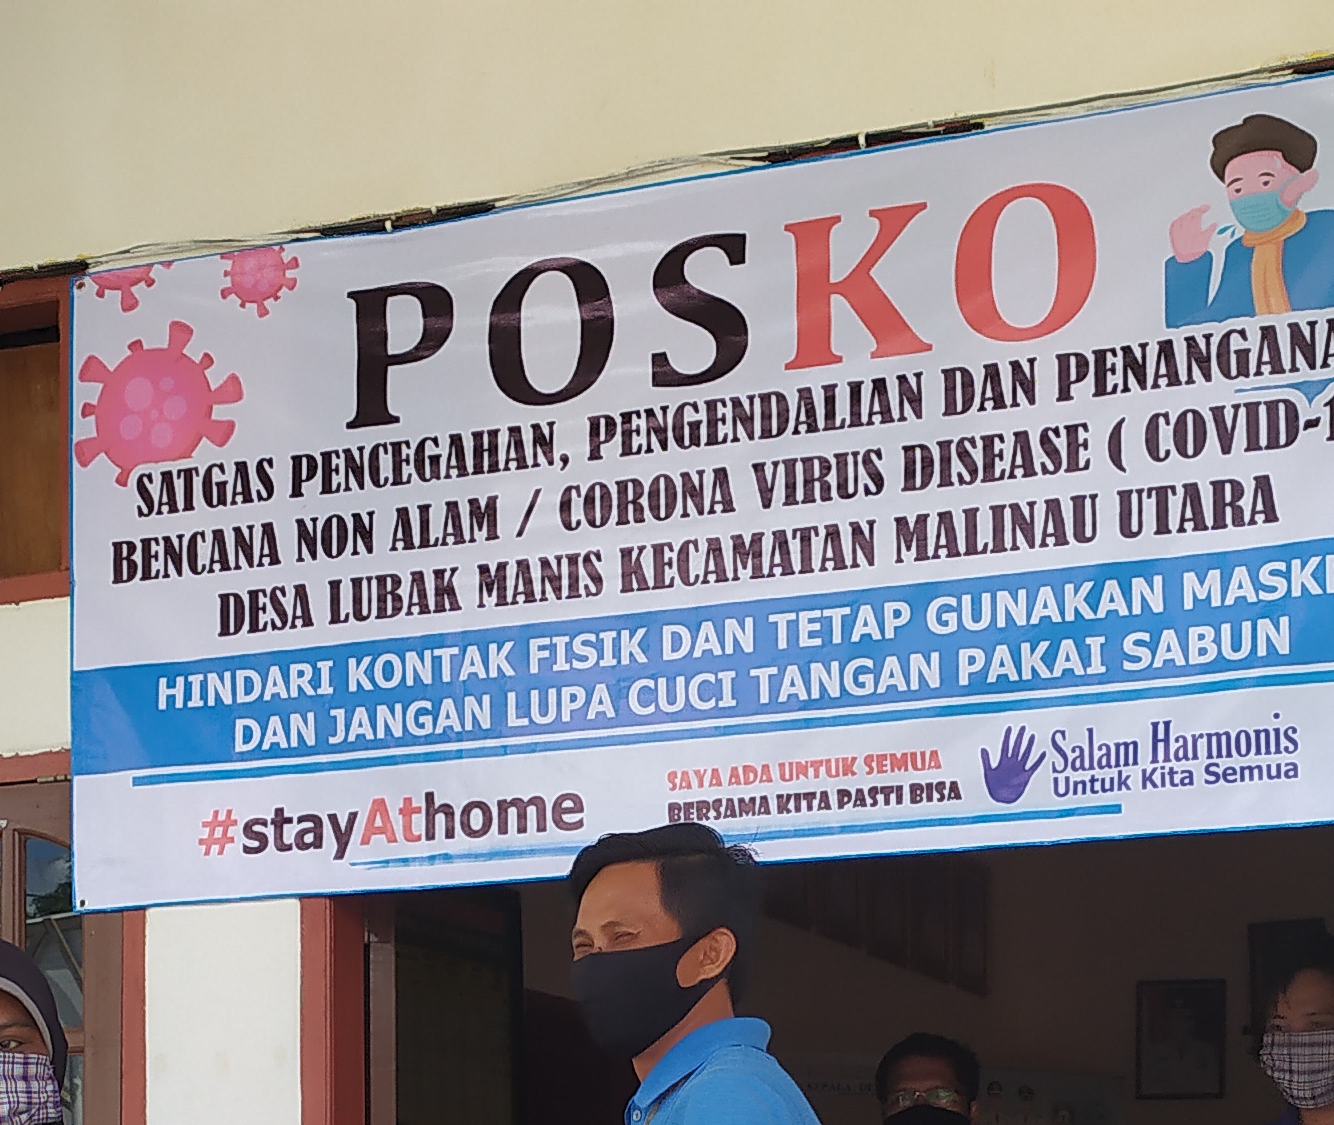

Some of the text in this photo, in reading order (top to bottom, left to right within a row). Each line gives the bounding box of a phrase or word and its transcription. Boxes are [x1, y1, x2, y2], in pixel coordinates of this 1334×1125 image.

[346, 182, 1098, 431] POSKO
[112, 521, 281, 584] BENCANA
[295, 511, 375, 562] NON
[389, 494, 500, 552] ALAM
[515, 488, 542, 538] /
[559, 466, 736, 531] CORONA
[751, 446, 884, 509] VIRUS
[901, 421, 1090, 493] DISEASE
[136, 457, 275, 518] SATGAS
[289, 420, 570, 499] PENCEGAHAN,
[587, 371, 924, 461] PENGENDALIAN
[941, 358, 1037, 417] DAN
[217, 473, 1279, 637] DESA LUBAK MANIS KECAMATAN MALINAU UTARA
[158, 659, 333, 710] HINDARI
[348, 641, 515, 693] KONTAK
[529, 627, 648, 673] FISIK
[662, 617, 754, 661] DAN
[769, 601, 911, 649] TETAP
[926, 575, 1163, 634] GUNAKAN
[234, 615, 1291, 752] DAN JANGAN LUPA CUCI TANGAN PAKAI SABUN
[667, 749, 942, 792] SAYA ADA UNTUK SEMUA
[668, 781, 963, 823] BERSAMA KITA PASTI BISA
[1051, 712, 1299, 774] Salam Harmonis
[1053, 761, 1299, 797] Untuk Kita Semua
[198, 791, 585, 861] #stayAthome
